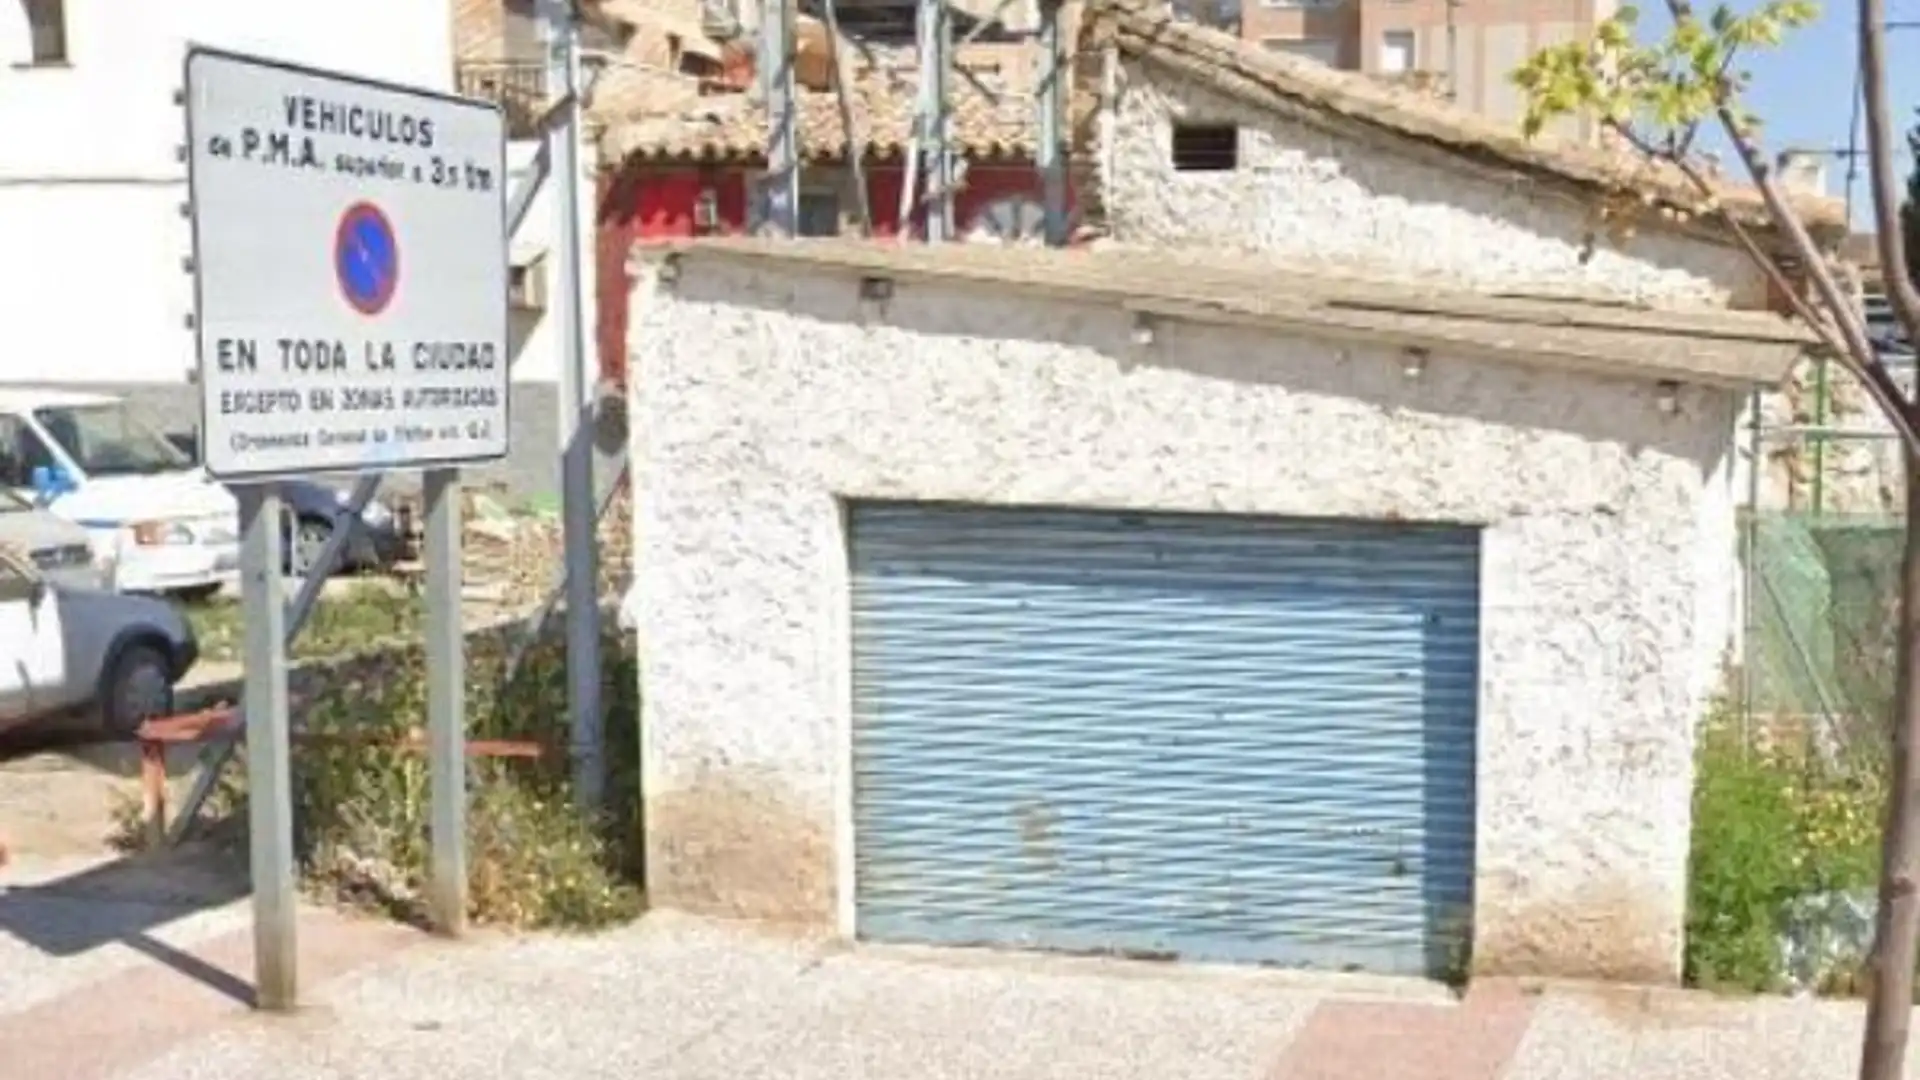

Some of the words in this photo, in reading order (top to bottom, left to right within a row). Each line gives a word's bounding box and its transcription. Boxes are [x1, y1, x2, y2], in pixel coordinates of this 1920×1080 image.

[283, 95, 434, 148] VEHICULOS
[217, 338, 258, 371] EN
[277, 338, 347, 371] TODA
[365, 339, 394, 371] LA
[413, 341, 496, 371] CIUDAD
[221, 388, 302, 414] EXCEPTO
[309, 387, 334, 411] EN
[341, 386, 394, 410] ZONAS
